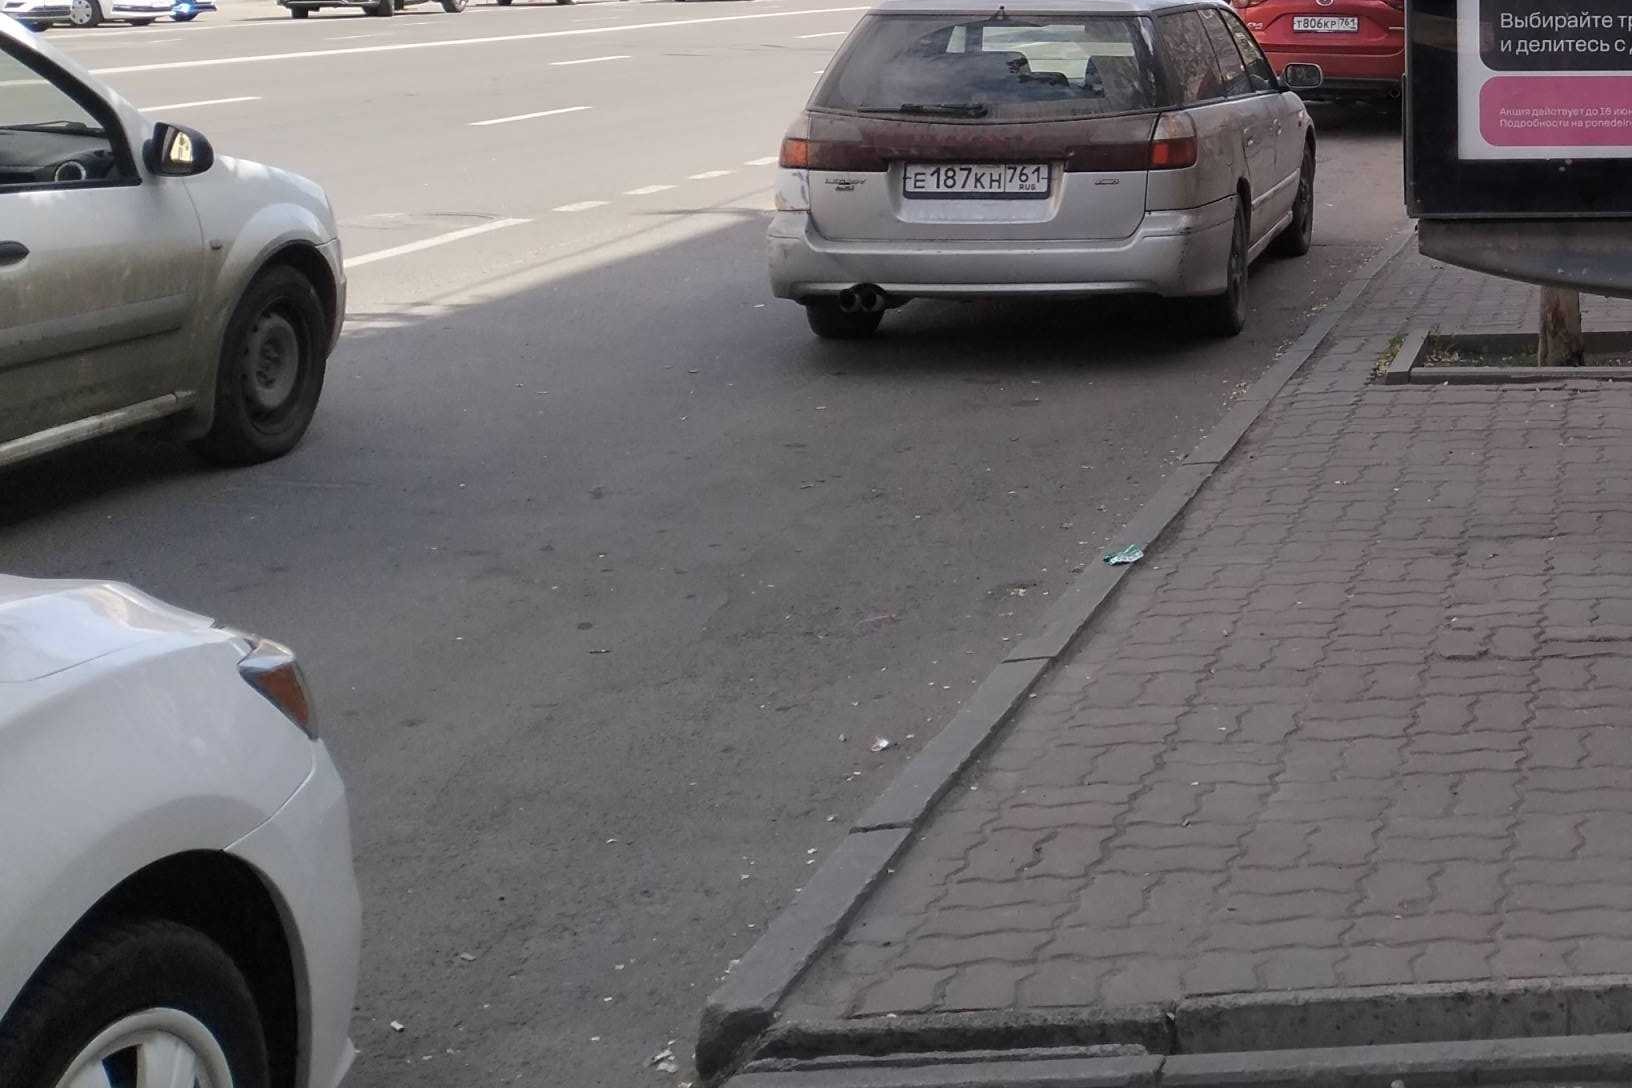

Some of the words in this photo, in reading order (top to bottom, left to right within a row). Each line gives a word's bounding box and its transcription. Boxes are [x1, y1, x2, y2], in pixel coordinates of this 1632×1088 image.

[1500, 11, 1613, 32] Выбирайте
[1500, 39, 1512, 52] и
[1515, 39, 1609, 55] делитесь
[1613, 39, 1626, 52] с
[1585, 108, 1599, 116] до
[1499, 119, 1570, 128] Подробности
[1570, 120, 1584, 128] на
[913, 167, 1001, 189] Е187КН
[1007, 166, 1041, 183] 761
[1018, 183, 1037, 191] RUS
